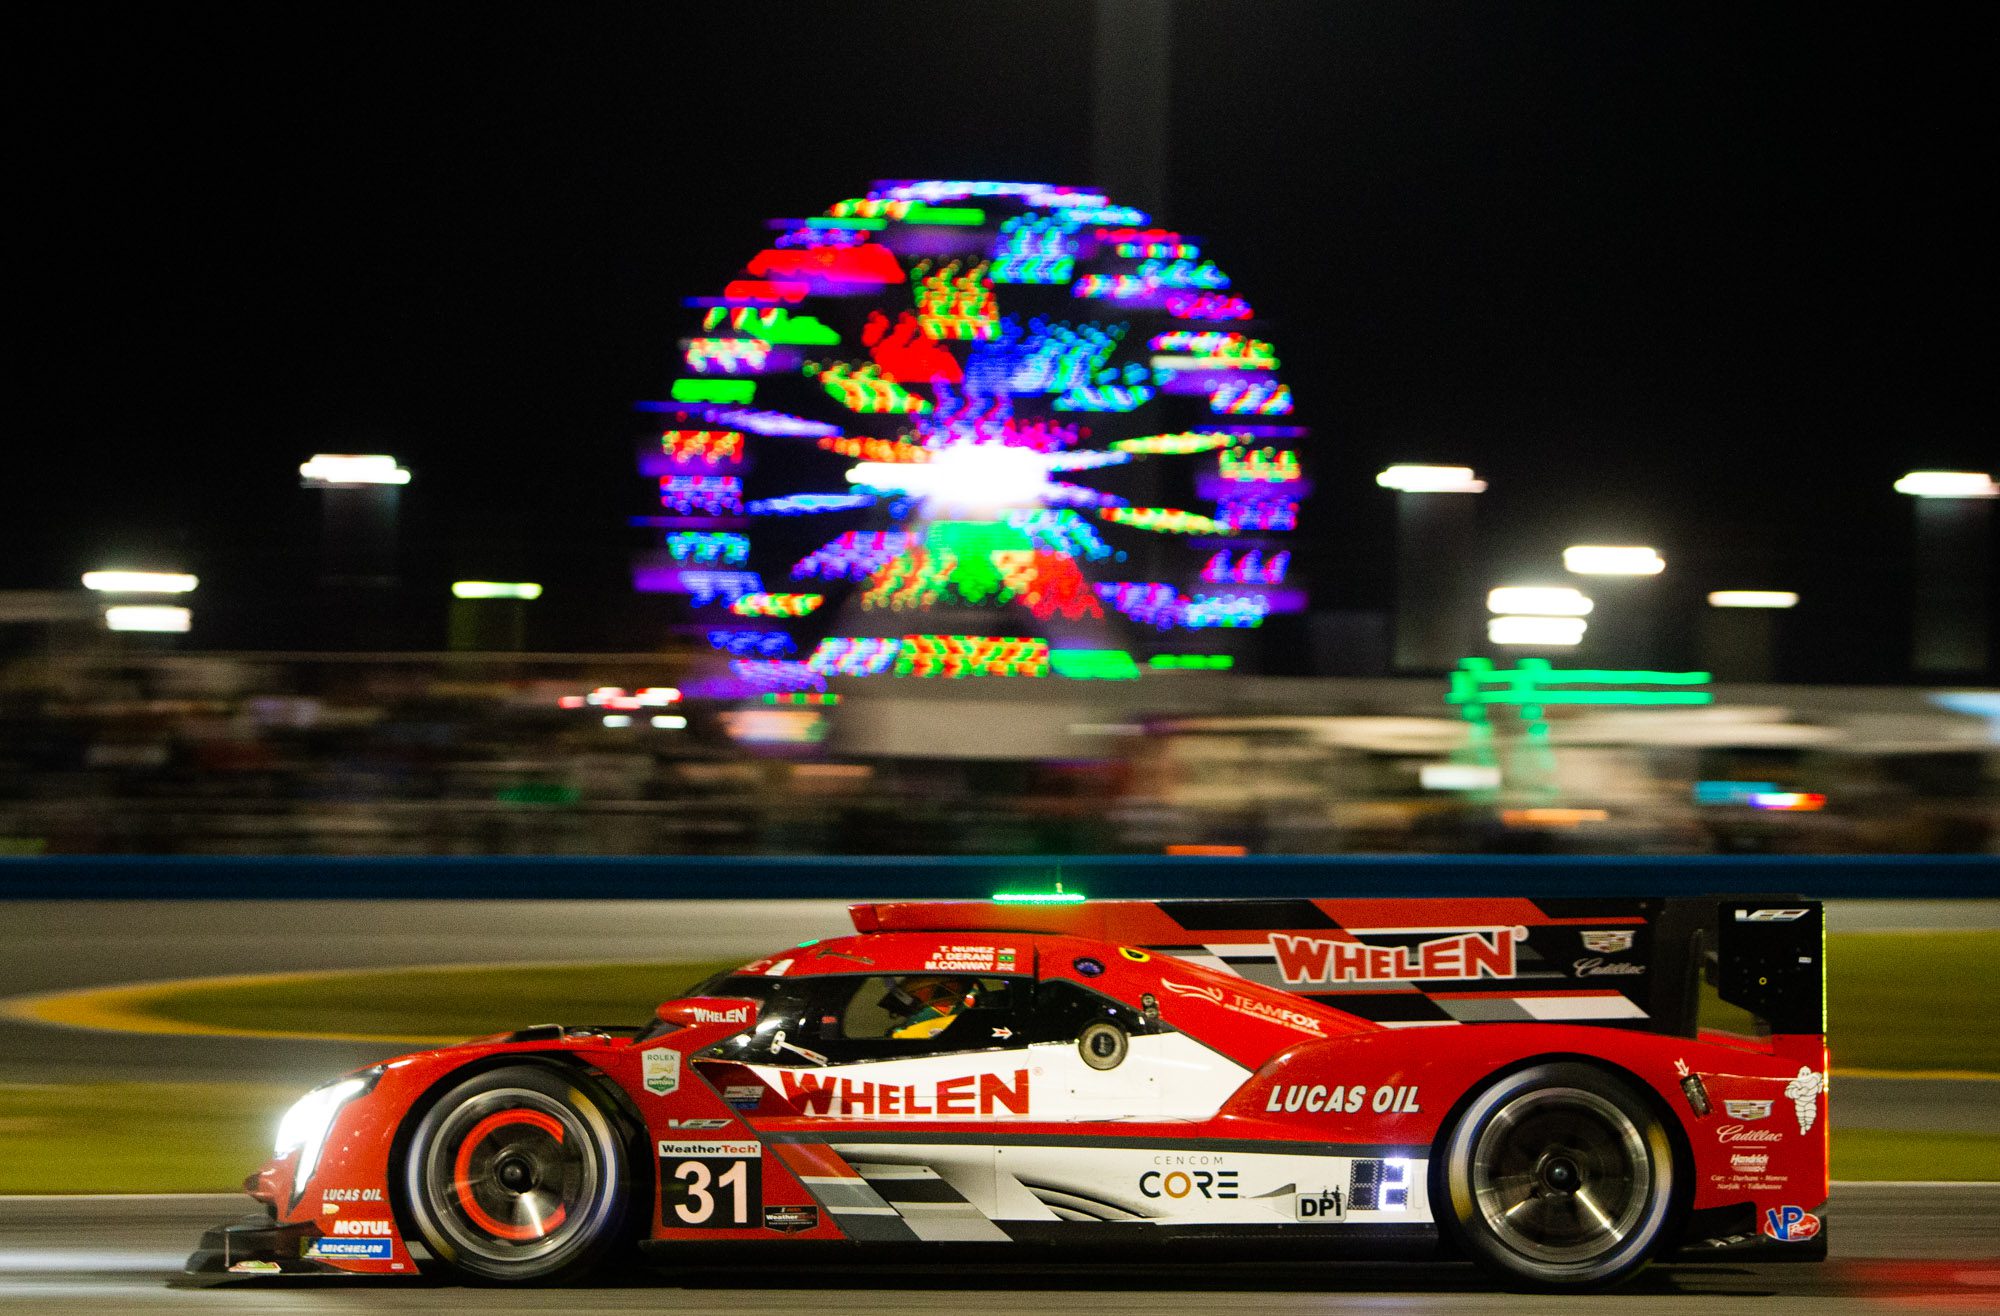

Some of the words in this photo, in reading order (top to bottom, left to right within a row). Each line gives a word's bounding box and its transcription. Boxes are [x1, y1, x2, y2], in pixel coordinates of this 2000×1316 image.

[945, 952, 994, 961] DERANI
[693, 1008, 747, 1023] WHELEN
[780, 1069, 1029, 1115] WHELEN
[1265, 1085, 1366, 1113] LUCAS
[1371, 1085, 1421, 1113] OIL
[1716, 1125, 1783, 1144] Cadillac
[1154, 1155, 1224, 1165] CENCOM
[674, 1160, 748, 1224] 31
[1139, 1171, 1239, 1199] CORE
[1378, 1157, 1411, 1211] 2
[323, 1189, 360, 1201] LUCAS
[362, 1189, 382, 1201] OIL
[333, 1220, 392, 1235] MOTUL
[321, 1244, 383, 1253] MICHELIN
